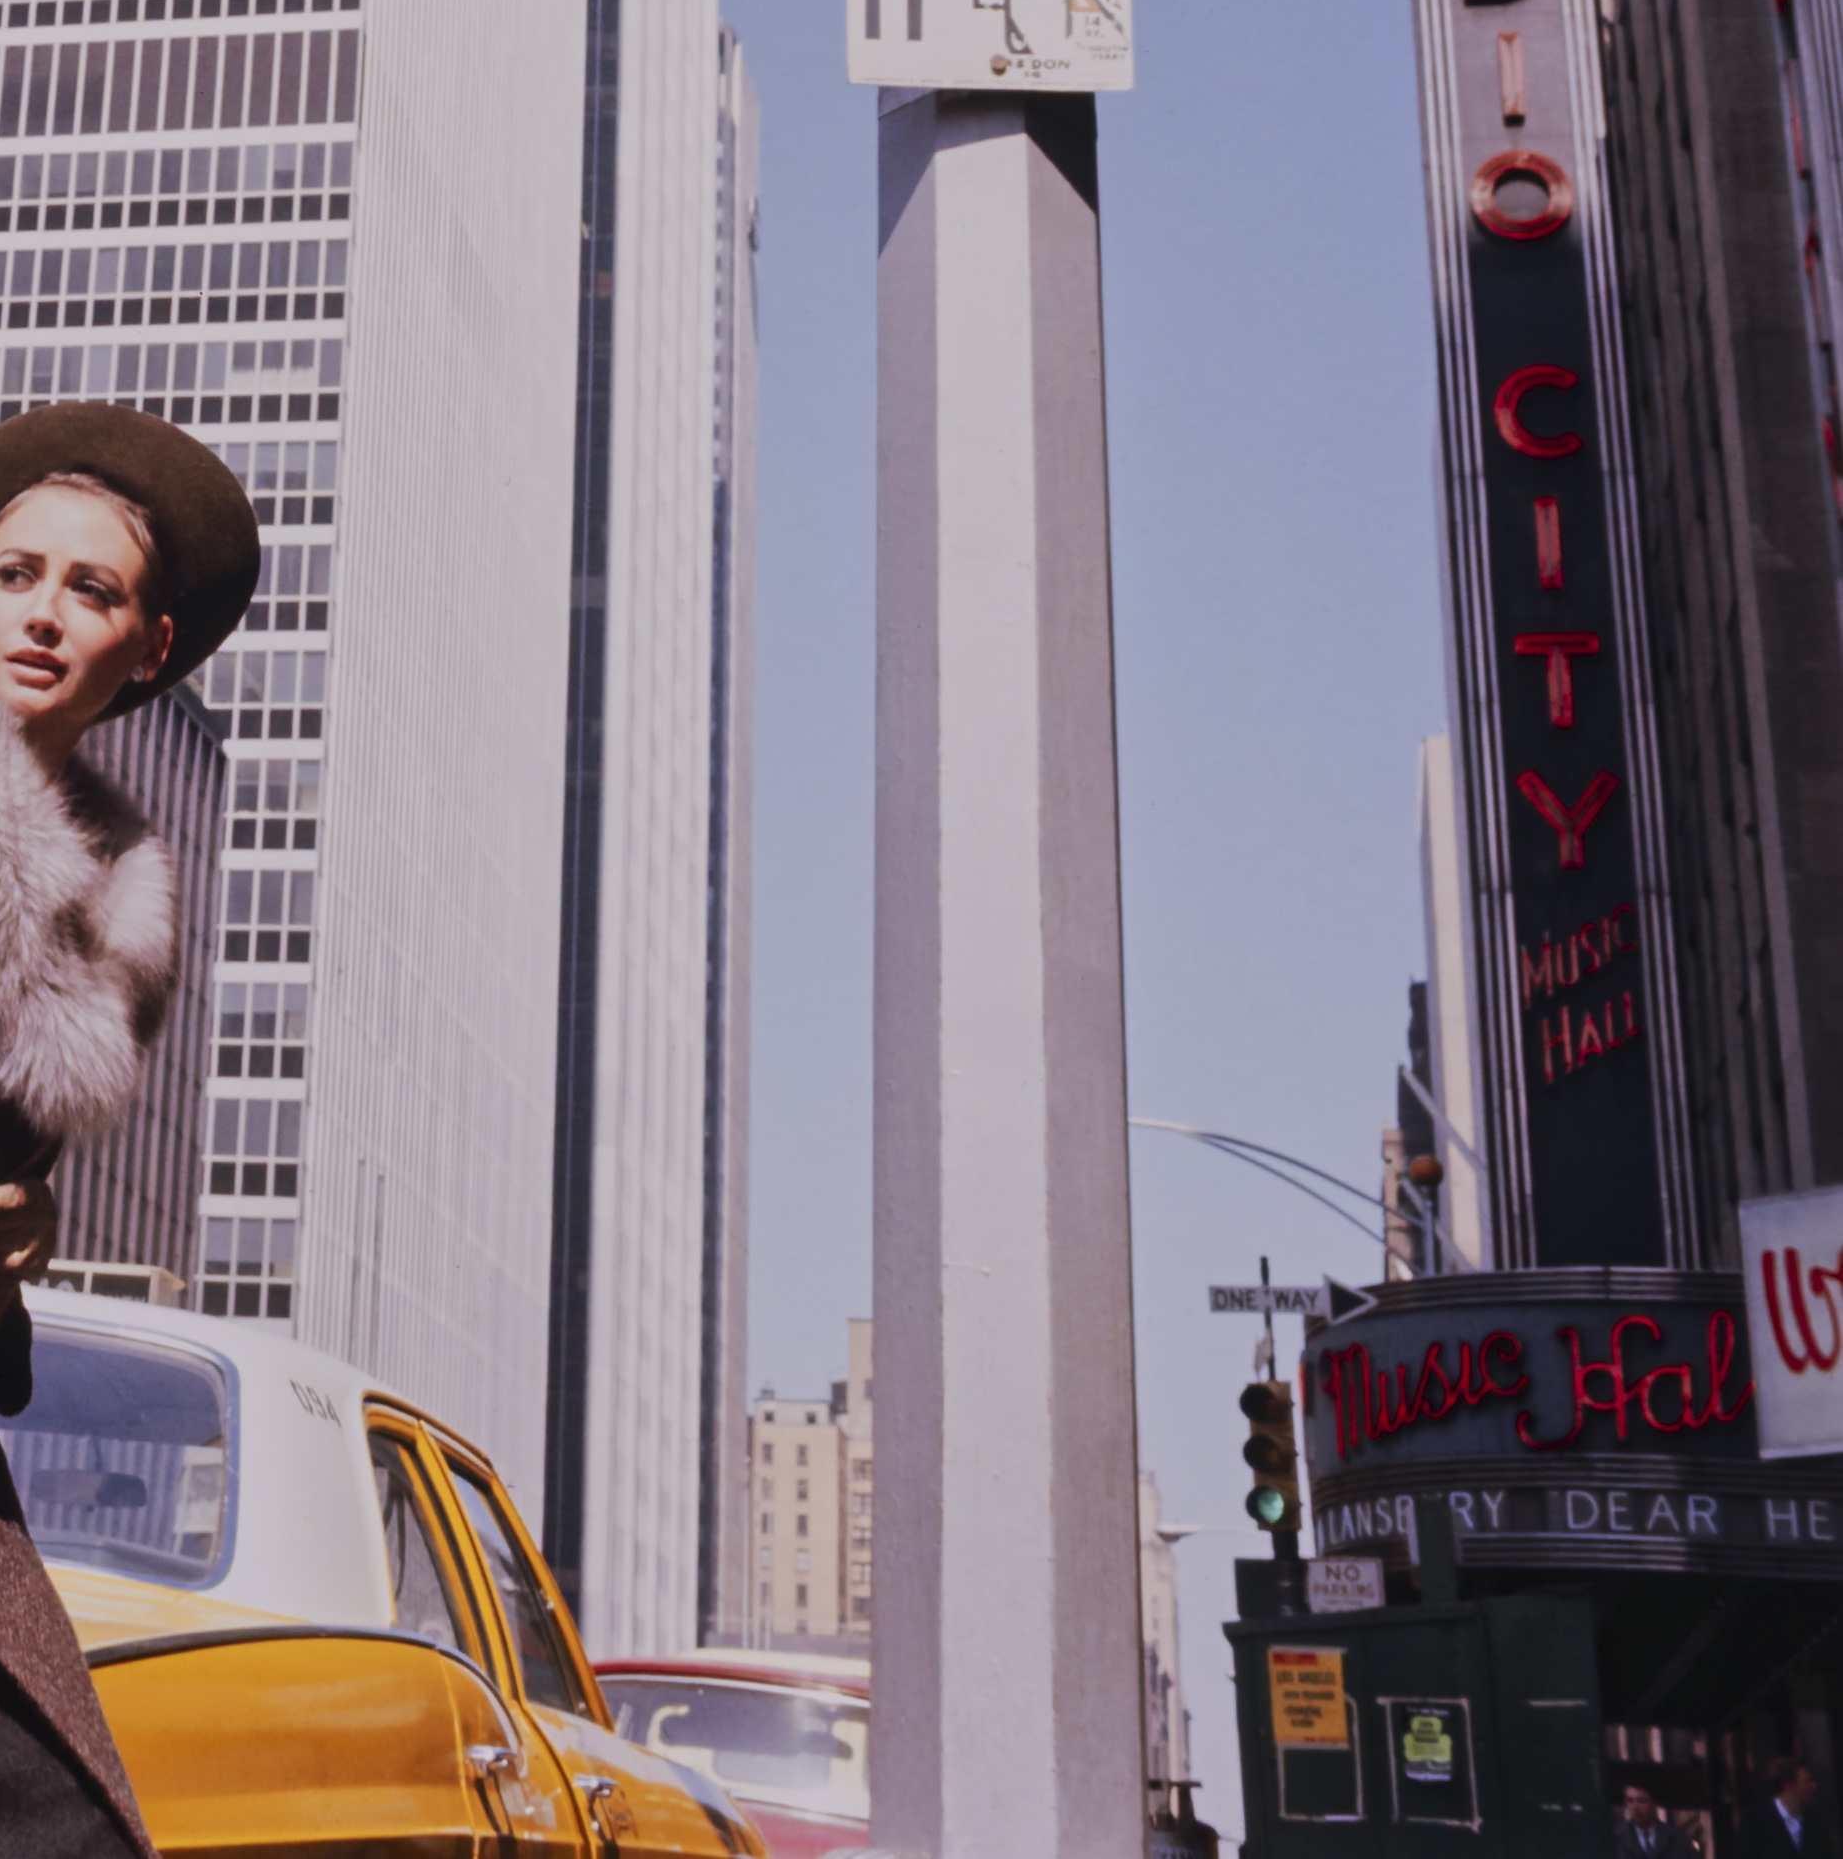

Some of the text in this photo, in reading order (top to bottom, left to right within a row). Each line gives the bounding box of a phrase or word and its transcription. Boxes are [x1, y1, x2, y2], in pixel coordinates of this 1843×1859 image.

[1494, 363, 1621, 870] CITY
[1520, 901, 1637, 1009] MUSIC
[1541, 989, 1643, 1085] HALL
[1213, 1288, 1320, 1311] ONE WAY
[1321, 1330, 1529, 1460] Music
[1328, 1490, 1505, 1546] LANSBRY
[1564, 1488, 1722, 1535] DEAR
[1324, 1564, 1361, 1583] NO
